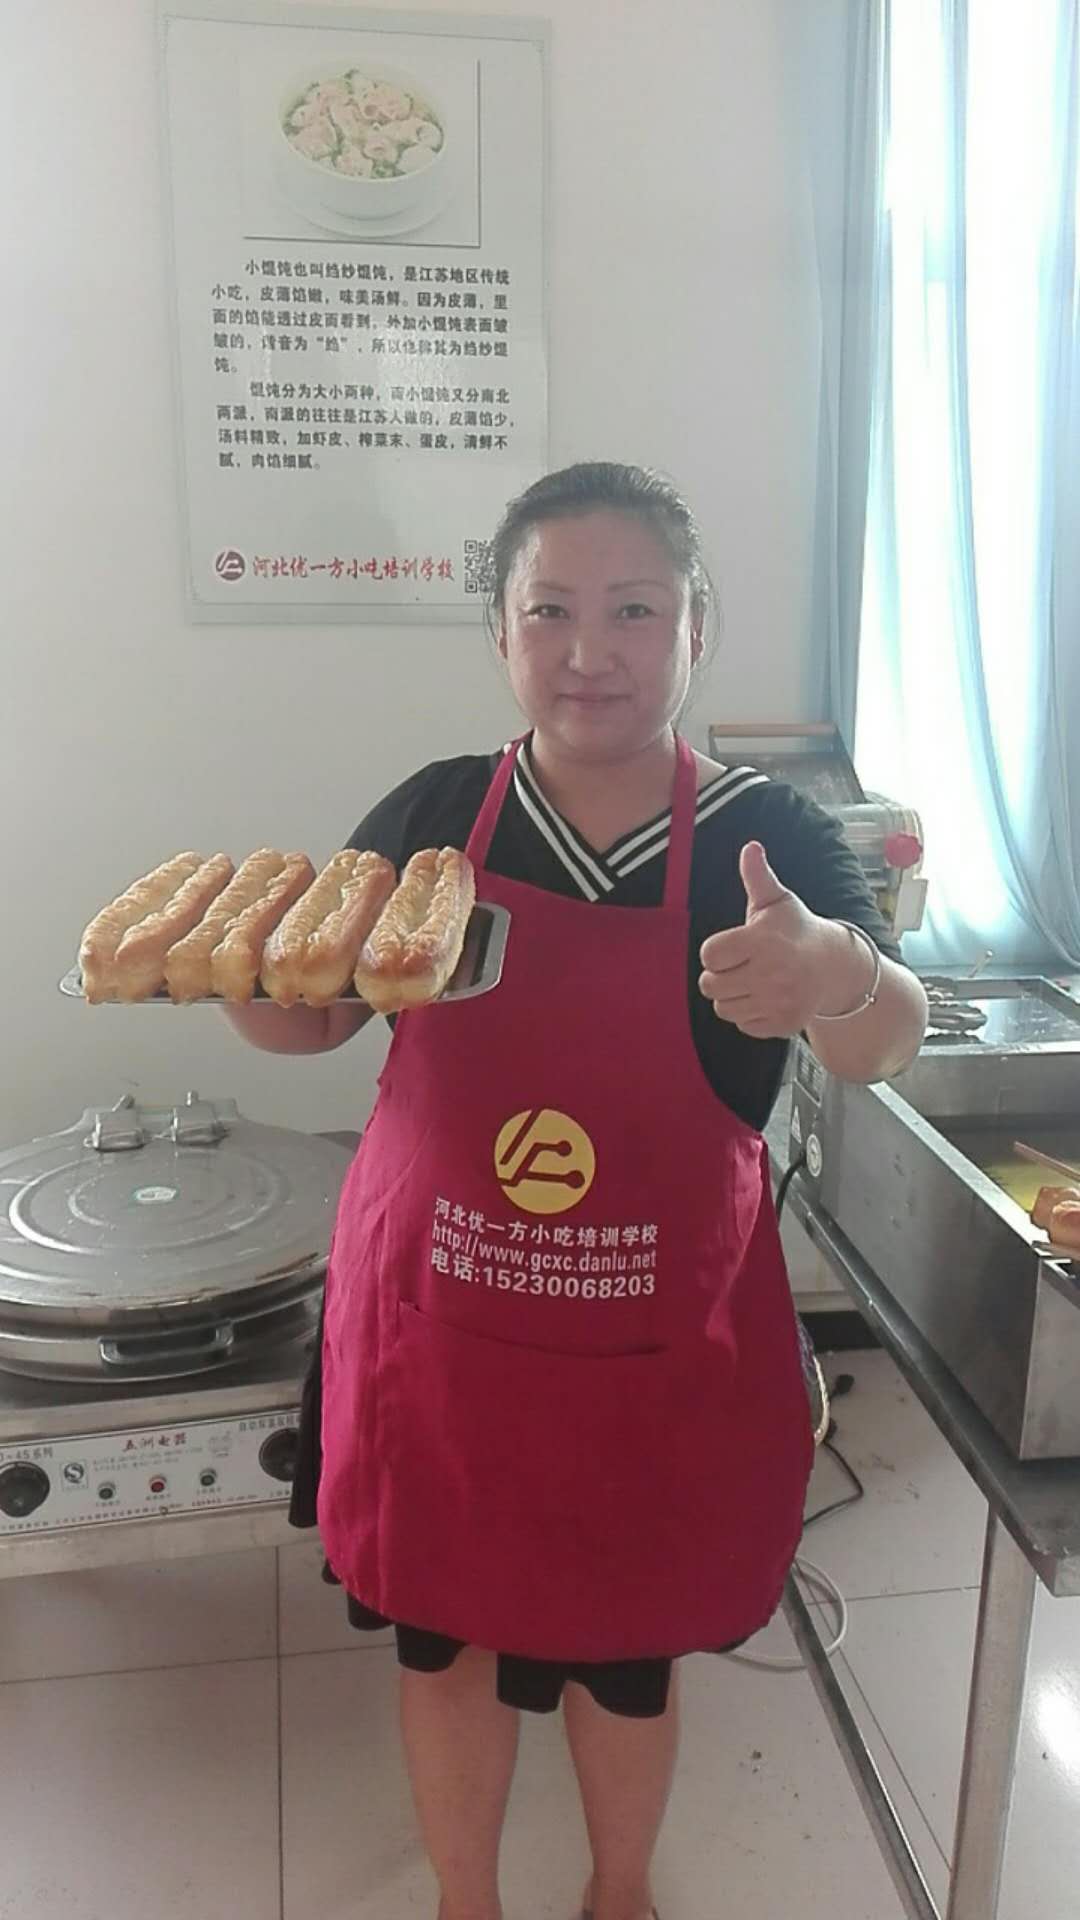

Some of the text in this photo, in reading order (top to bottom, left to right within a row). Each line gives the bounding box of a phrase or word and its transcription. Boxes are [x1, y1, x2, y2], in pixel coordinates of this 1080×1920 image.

[252, 555, 455, 582] 河北优一方小吃培训学校
[432, 1220, 657, 1273] http://www.gcxc.danlu.net
[435, 1197, 658, 1248] 河北优一方小吃培训学校
[431, 1246, 656, 1299] 电话:15230068203
